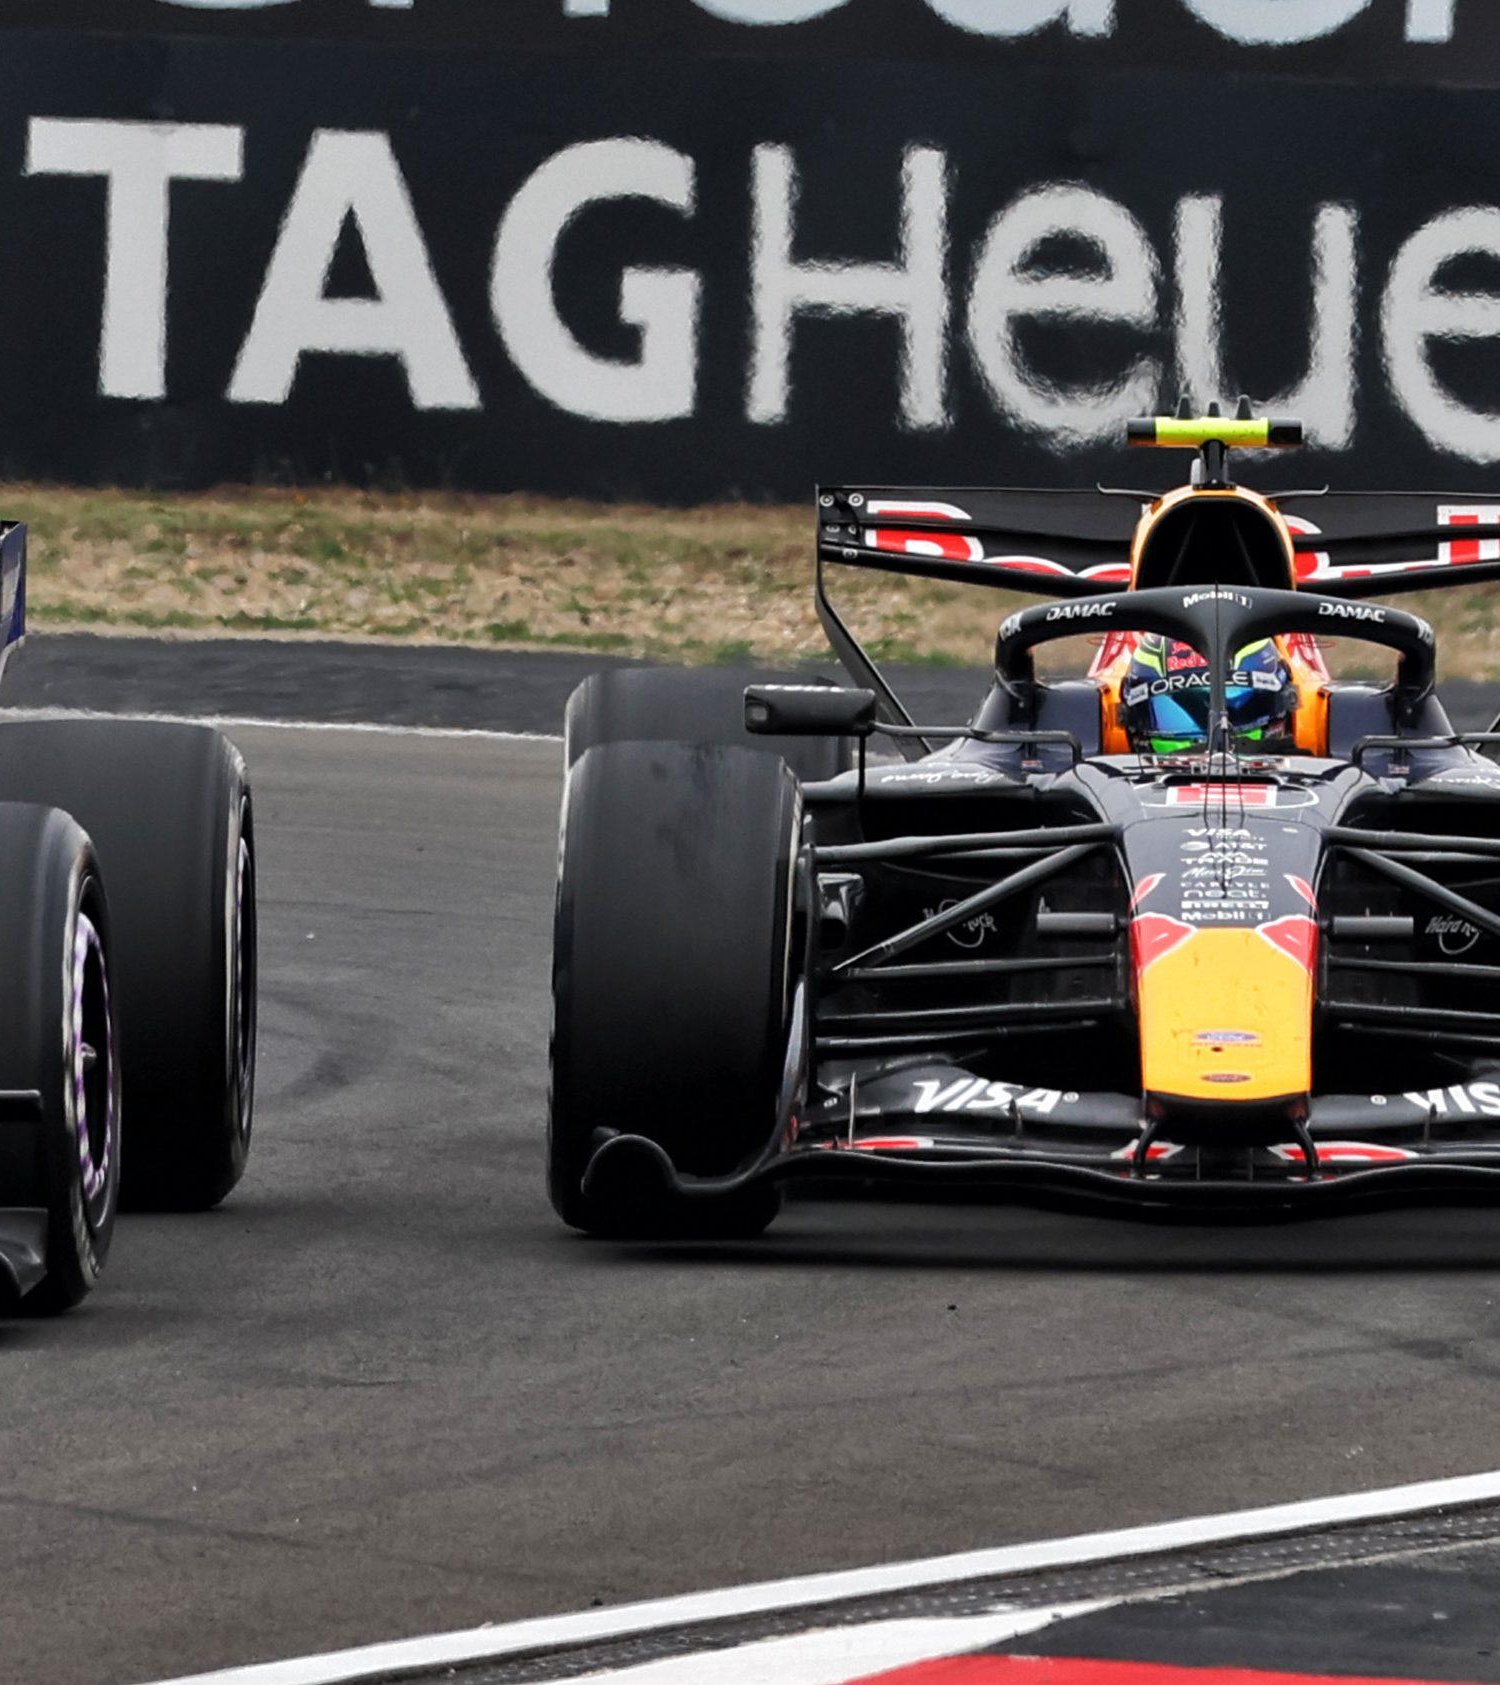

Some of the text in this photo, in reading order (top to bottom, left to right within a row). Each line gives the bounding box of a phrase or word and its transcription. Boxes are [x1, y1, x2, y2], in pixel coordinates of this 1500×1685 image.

[1046, 601, 1117, 622] DAMAC
[1318, 602, 1387, 624] DAMAC
[912, 1078, 1063, 1115] VISA
